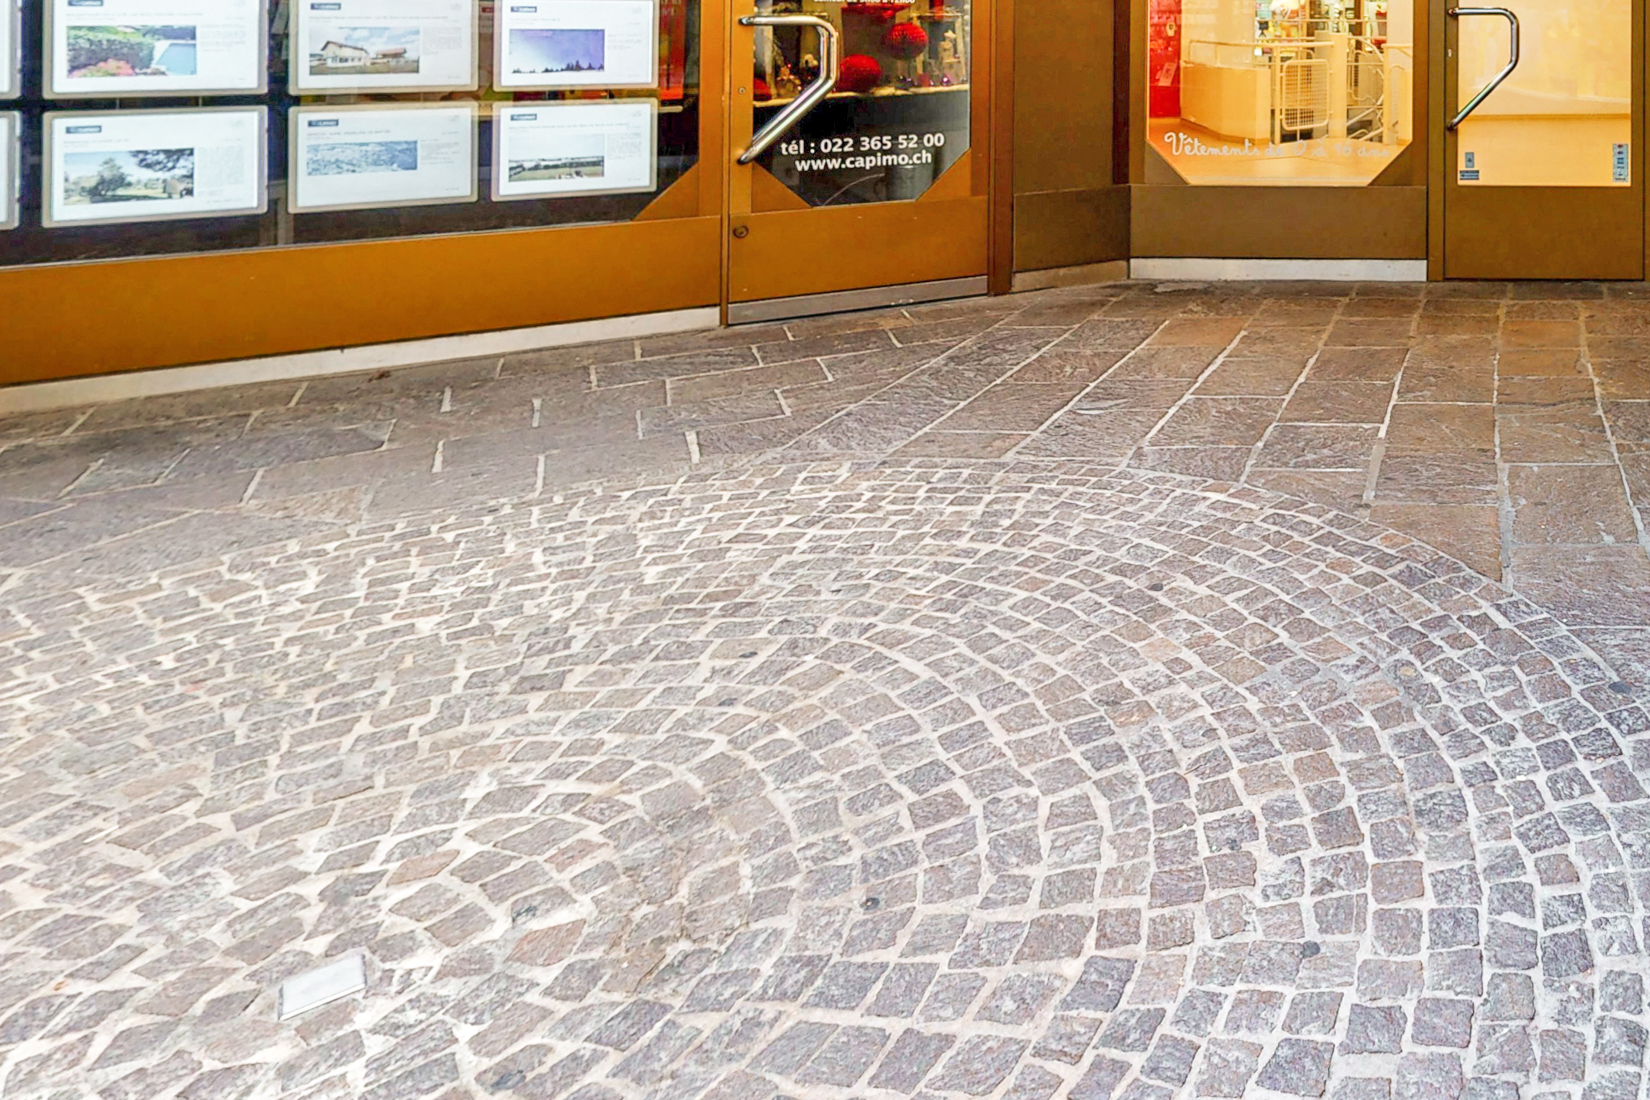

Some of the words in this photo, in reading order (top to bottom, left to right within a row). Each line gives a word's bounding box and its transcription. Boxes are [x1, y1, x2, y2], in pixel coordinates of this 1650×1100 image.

[780, 140, 804, 155] tél
[820, 138, 854, 153] 022
[859, 136, 892, 151] 365
[897, 134, 918, 148] 52
[923, 133, 945, 147] 00
[1164, 132, 1260, 156] Vêtements
[795, 150, 932, 171] www.capimo.ch
